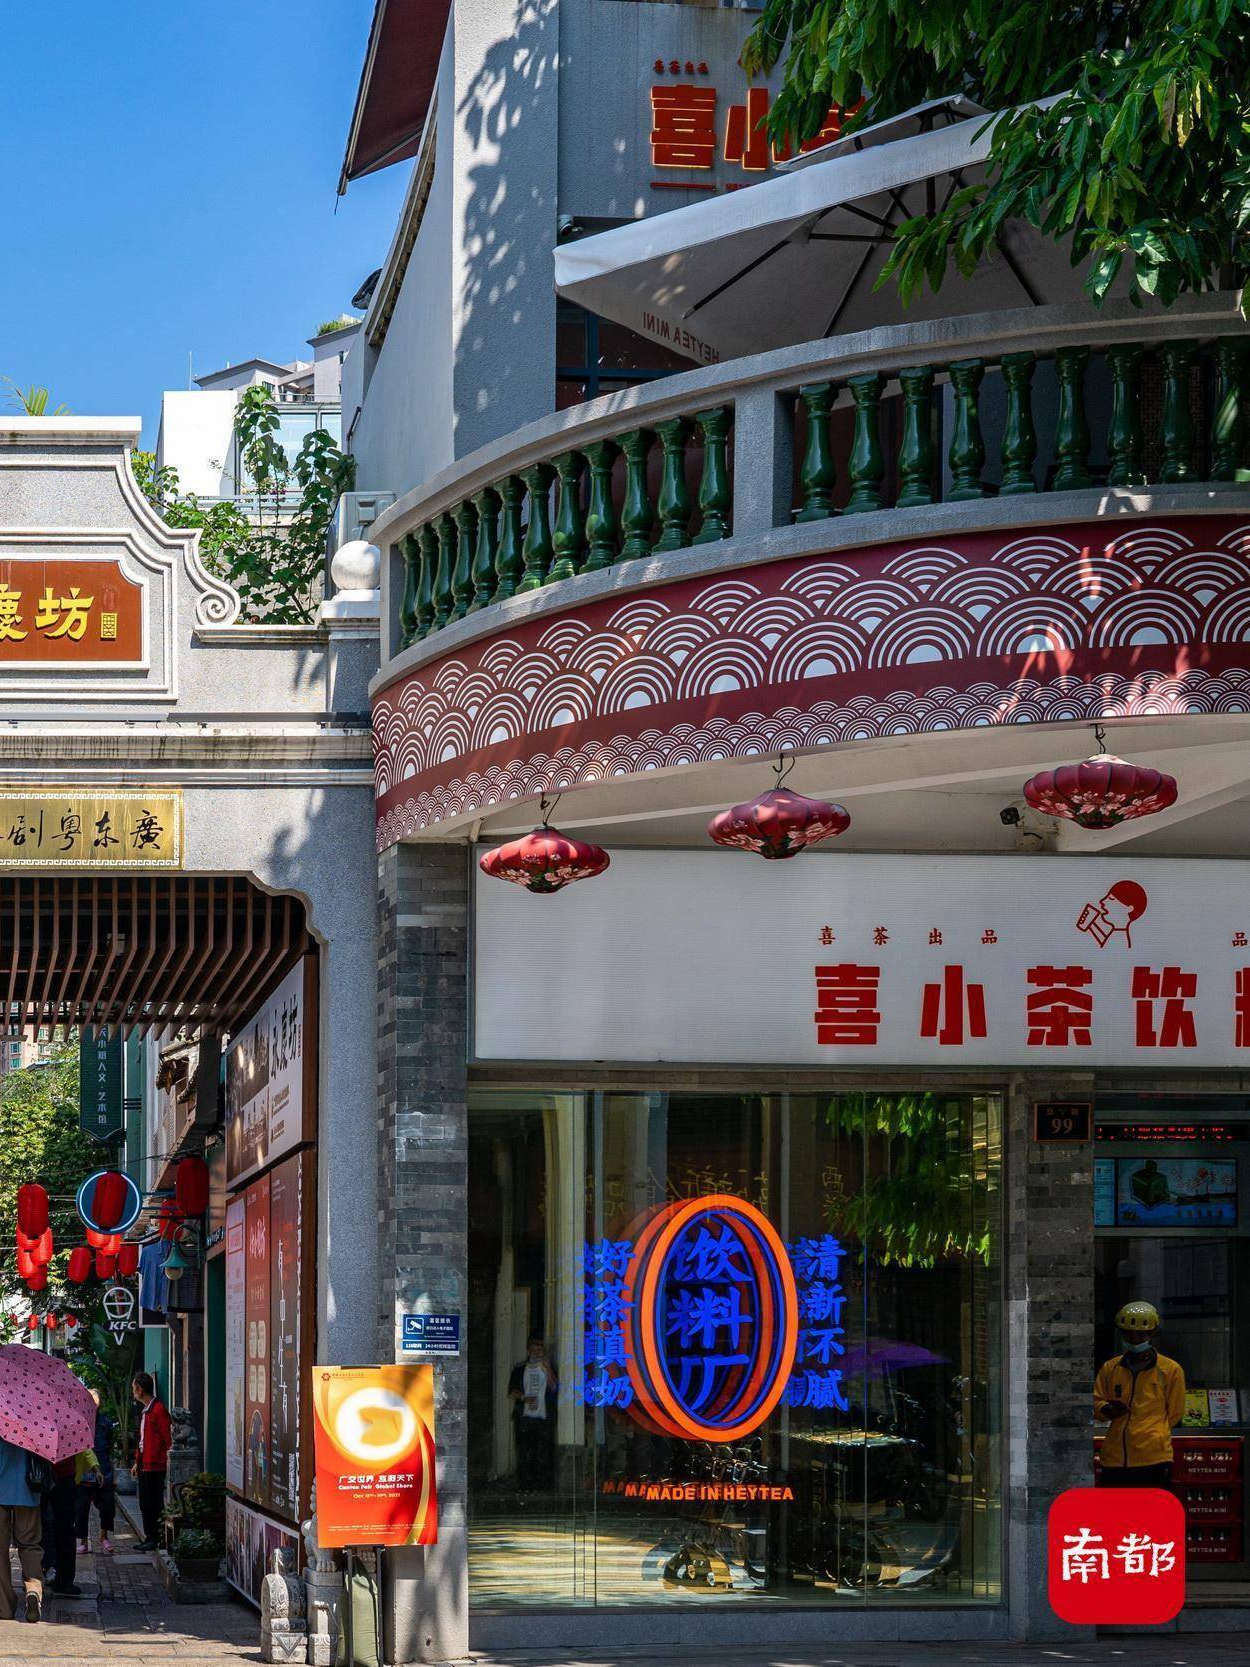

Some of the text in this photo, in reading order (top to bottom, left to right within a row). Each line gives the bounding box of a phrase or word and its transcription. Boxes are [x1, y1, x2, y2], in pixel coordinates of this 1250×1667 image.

[818, 925, 998, 946] 喜茶出品
[1050, 1118, 1074, 1134] 99
[108, 1321, 136, 1330] KFC
[687, 1226, 754, 1410] 饮料厂
[647, 1487, 794, 1500] MADE IN HEYTEA
